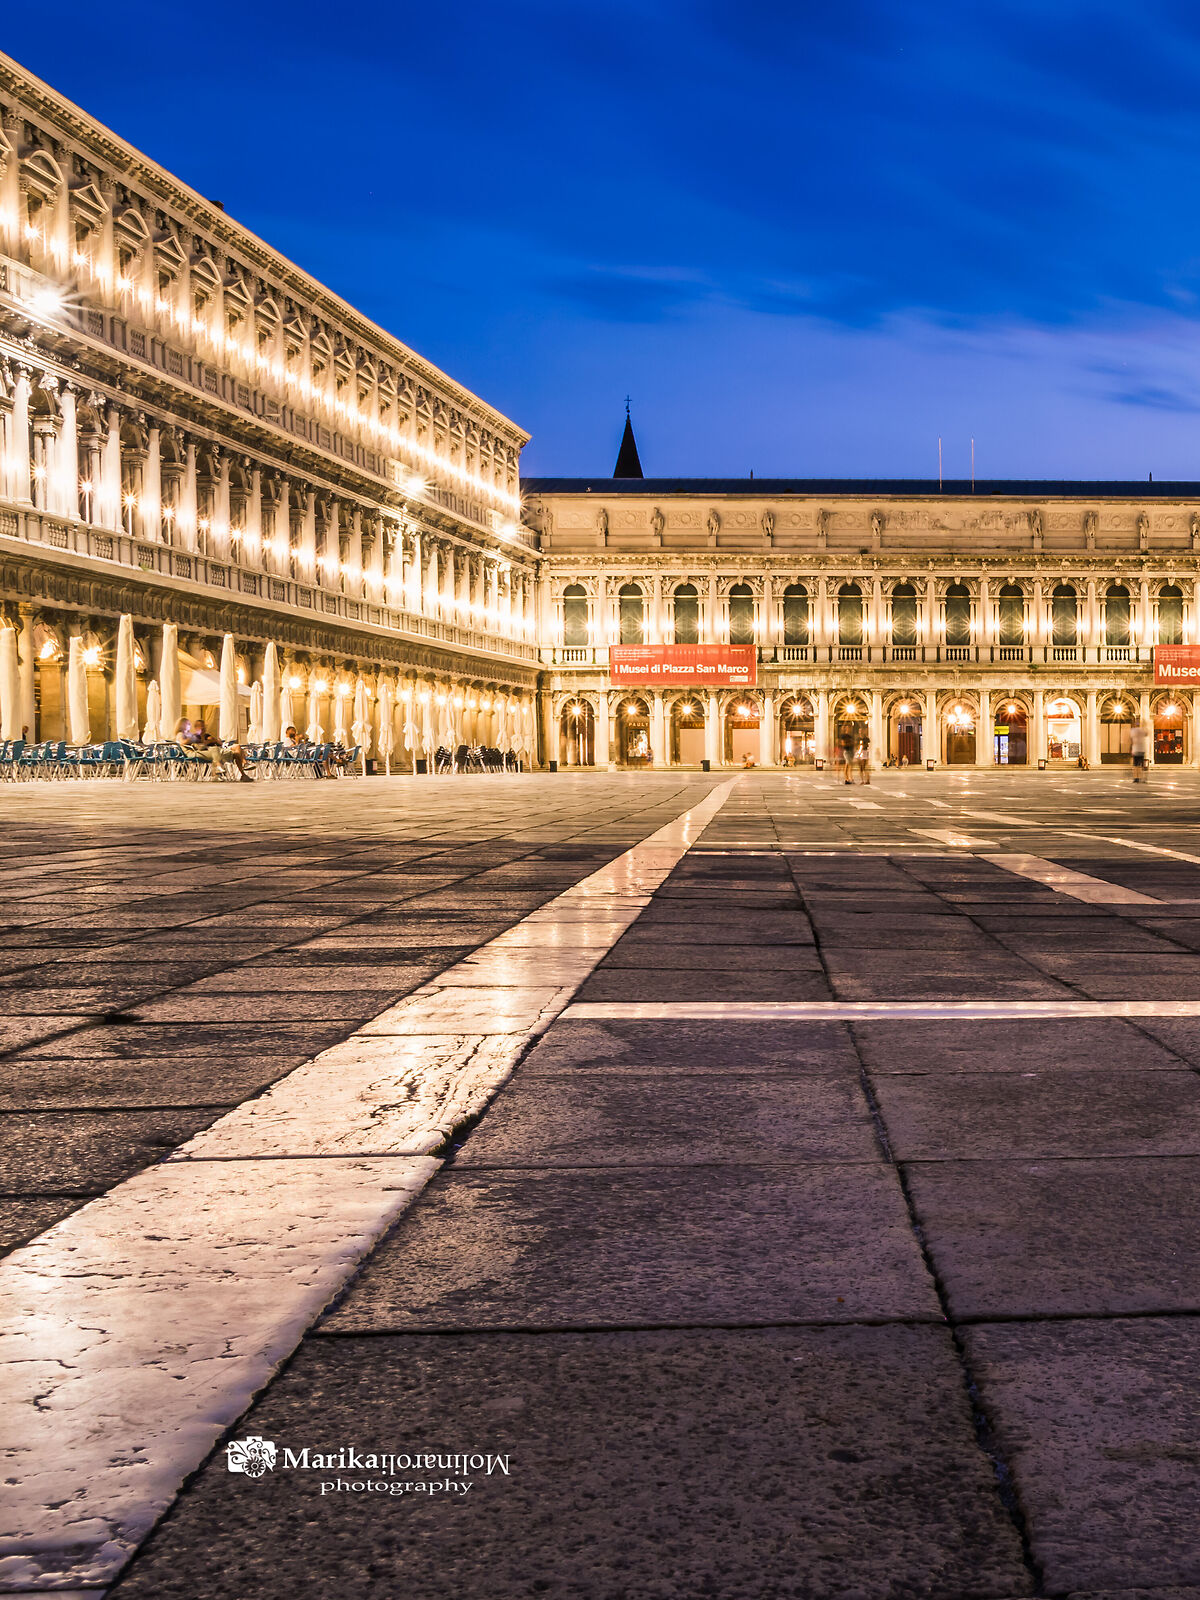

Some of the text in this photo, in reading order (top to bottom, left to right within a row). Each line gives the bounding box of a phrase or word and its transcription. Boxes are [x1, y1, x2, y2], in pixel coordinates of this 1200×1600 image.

[614, 663, 748, 674] I Musei di Piazza San Marco
